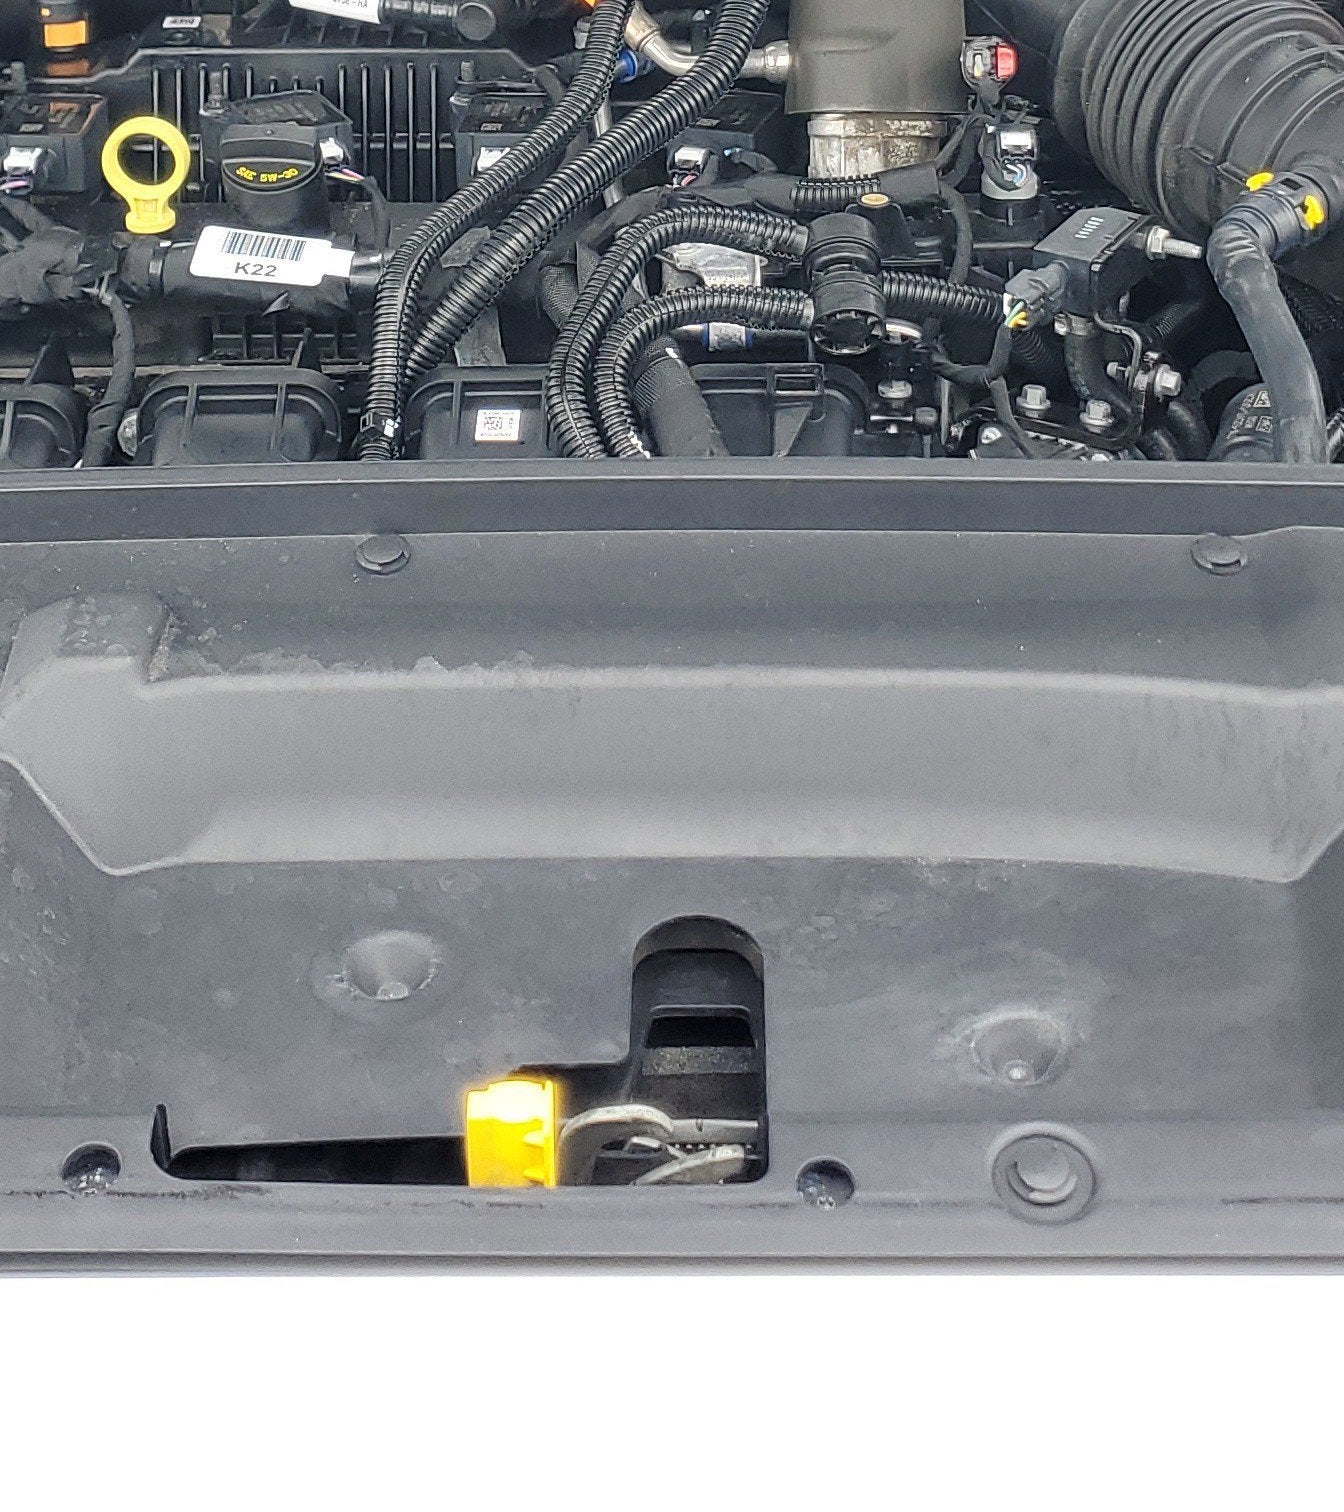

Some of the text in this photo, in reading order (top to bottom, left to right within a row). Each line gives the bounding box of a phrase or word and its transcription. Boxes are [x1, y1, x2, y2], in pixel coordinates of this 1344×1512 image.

[236, 166, 299, 182] SAE 5W-30
[234, 261, 277, 277] K22
